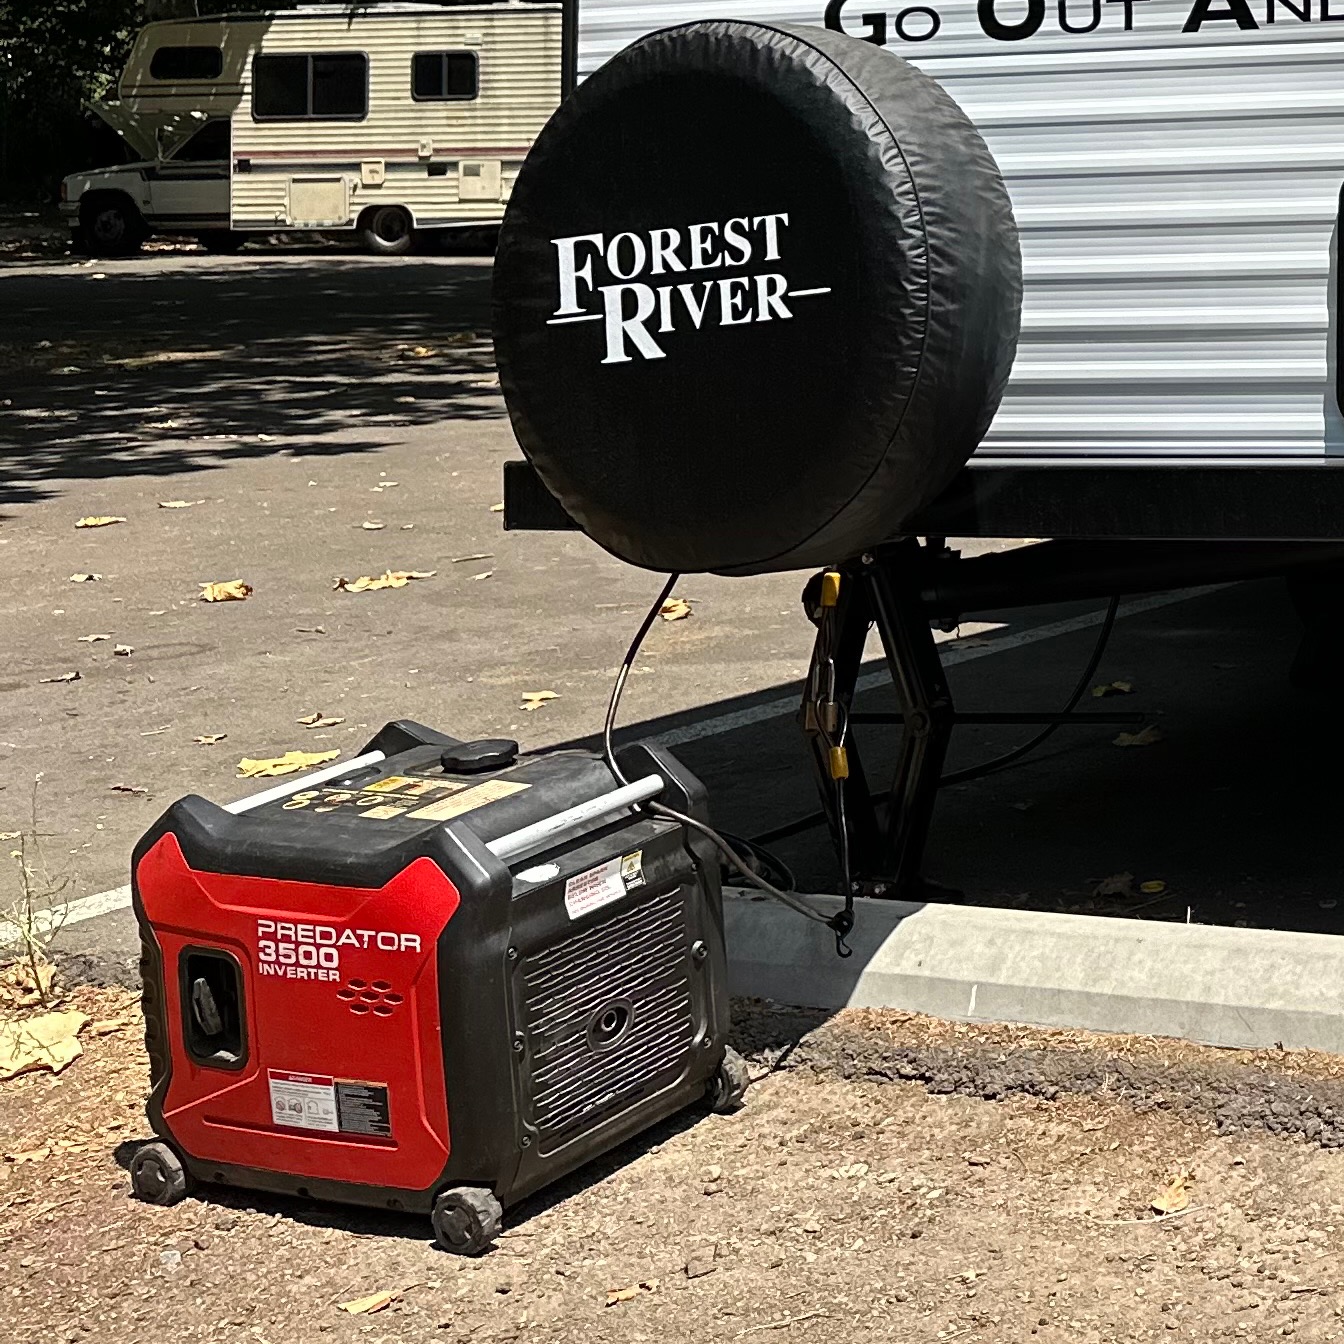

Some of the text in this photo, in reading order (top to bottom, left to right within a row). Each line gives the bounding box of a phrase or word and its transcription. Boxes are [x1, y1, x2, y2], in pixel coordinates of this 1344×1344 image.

[550, 212, 789, 316] FOREST
[597, 273, 794, 364] RIVER
[257, 919, 422, 953] PREDATOR
[258, 939, 340, 969] 3500
[258, 961, 341, 982] INVERTER
